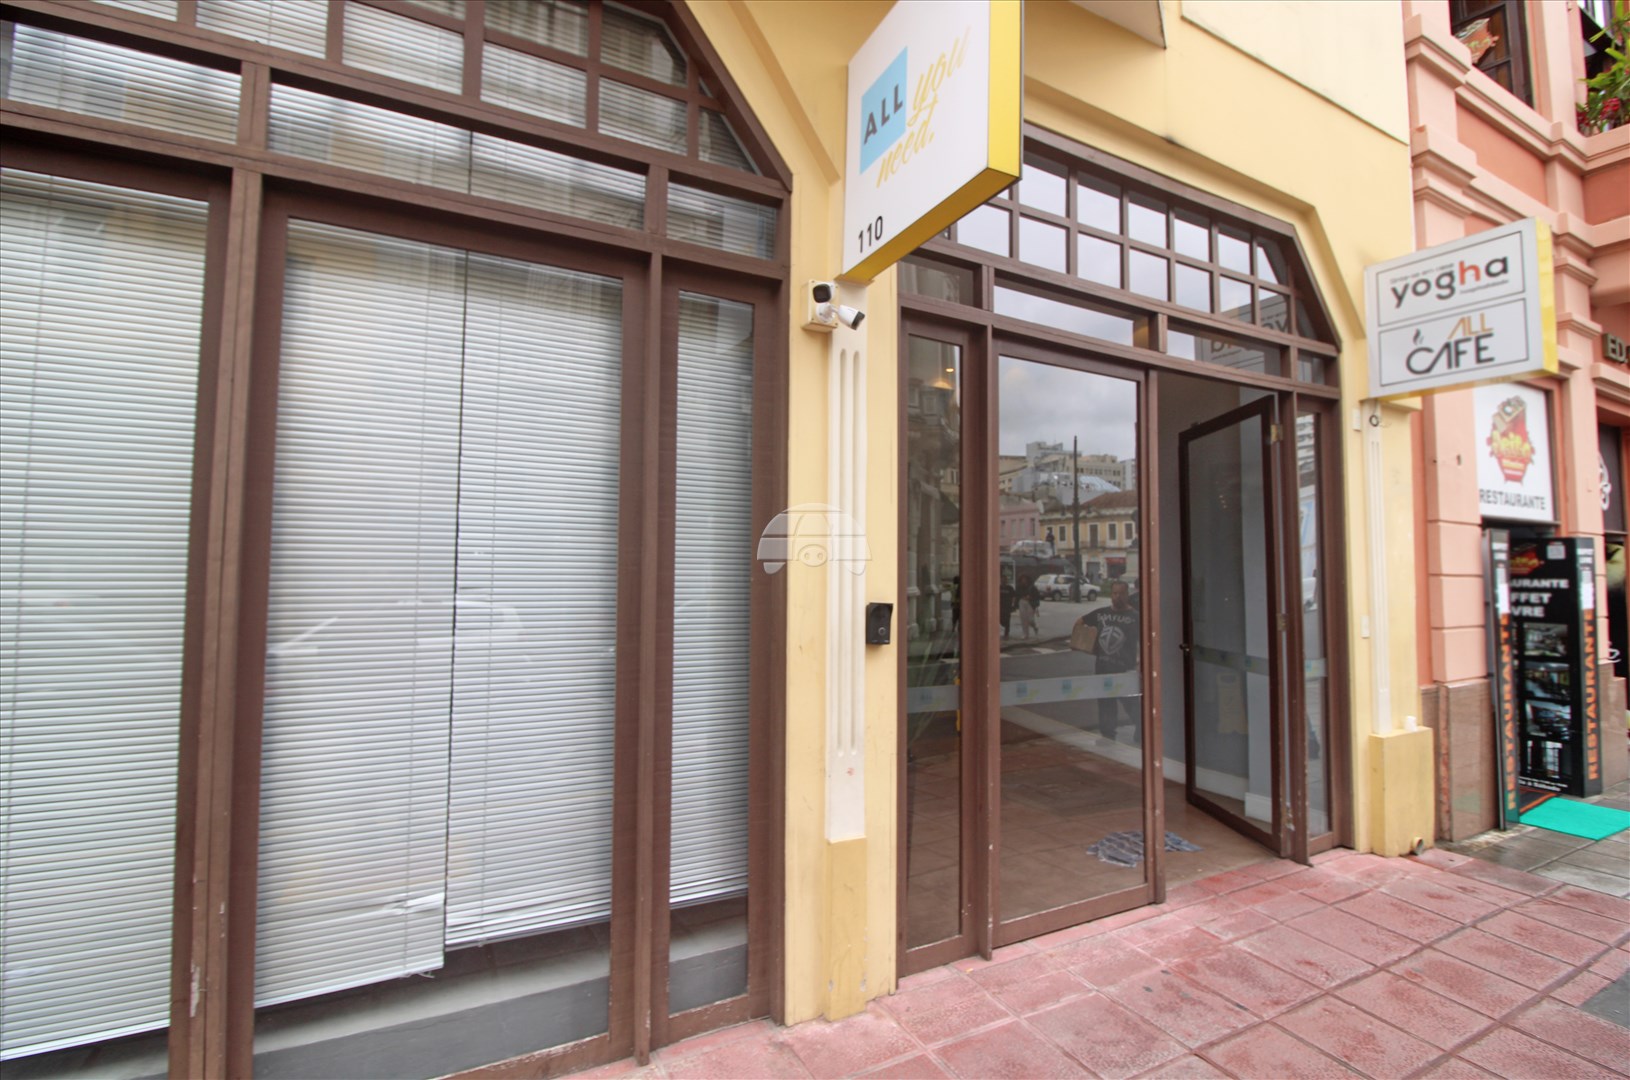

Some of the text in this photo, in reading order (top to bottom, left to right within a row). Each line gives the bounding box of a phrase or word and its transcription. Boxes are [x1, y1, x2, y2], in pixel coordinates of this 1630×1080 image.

[863, 25, 971, 145] ALL you
[858, 215, 883, 254] 110
[1391, 256, 1509, 309] yogha
[1447, 312, 1494, 339] ALL
[1405, 333, 1496, 375] CAFE
[1479, 488, 1547, 510] RESTAURANTE
[1500, 613, 1517, 811] RESTAURANTE
[1582, 609, 1600, 781] RESTAURANTE
